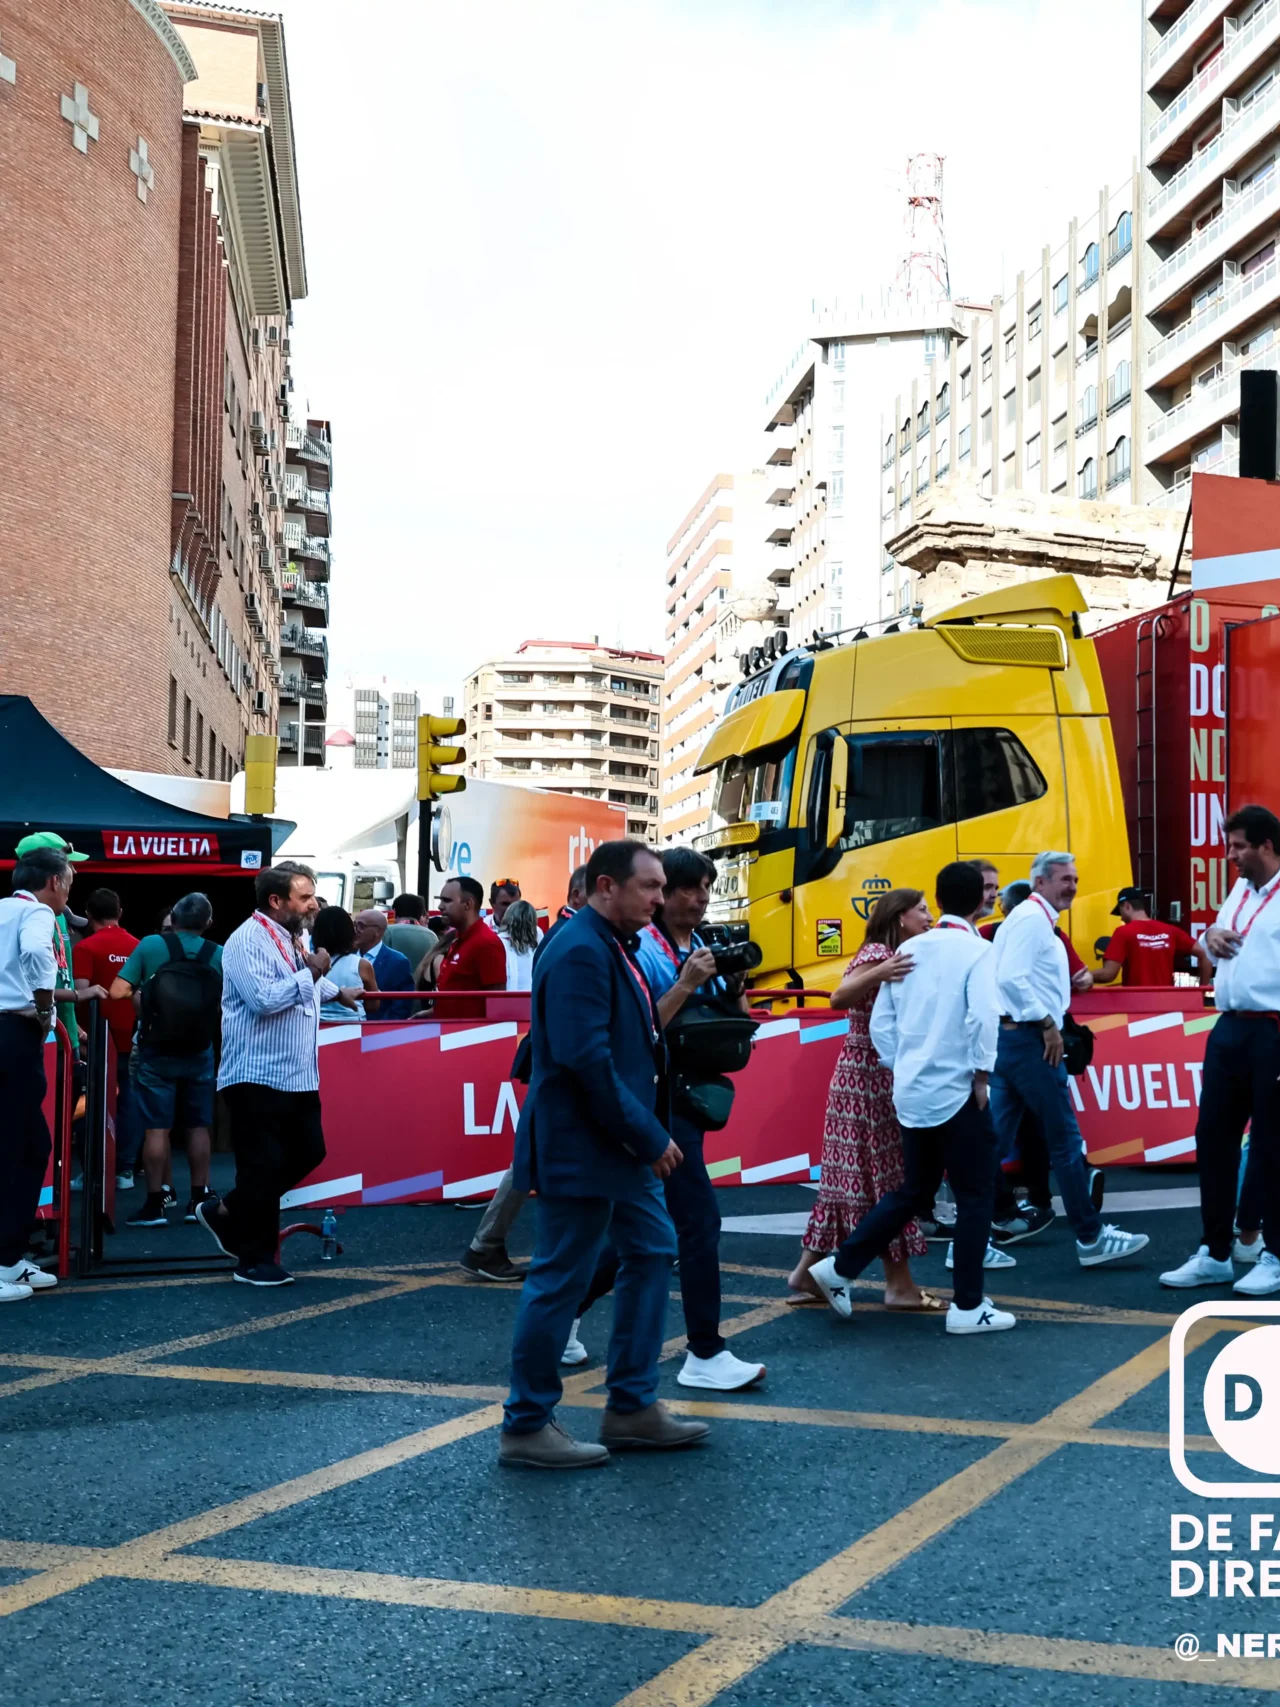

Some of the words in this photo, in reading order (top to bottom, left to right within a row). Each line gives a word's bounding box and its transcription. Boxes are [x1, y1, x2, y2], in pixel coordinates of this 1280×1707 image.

[113, 835, 136, 855] LA
[140, 836, 211, 857] VUELTA
[1089, 1062, 1204, 1112] VUELT
